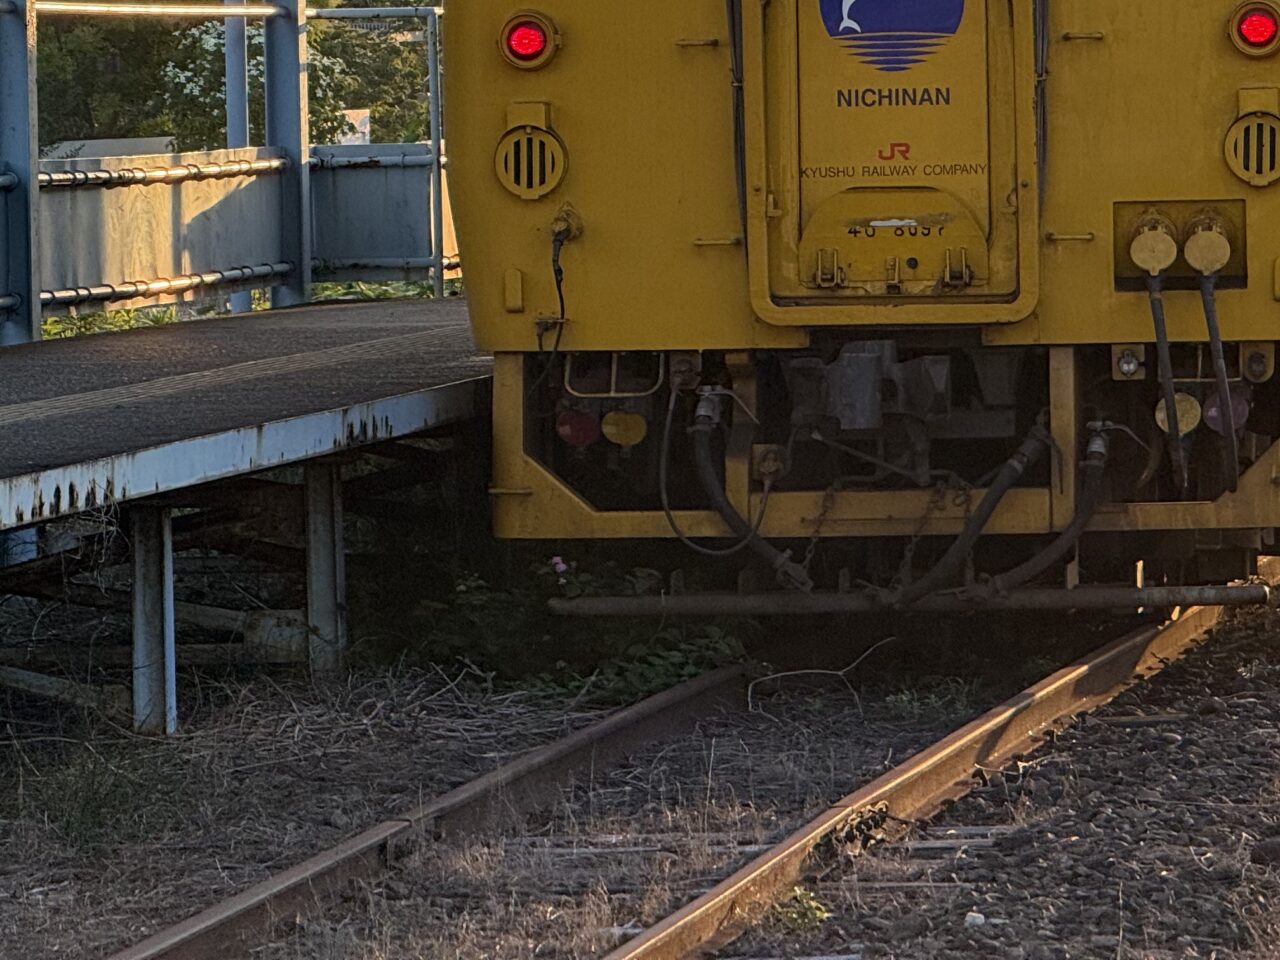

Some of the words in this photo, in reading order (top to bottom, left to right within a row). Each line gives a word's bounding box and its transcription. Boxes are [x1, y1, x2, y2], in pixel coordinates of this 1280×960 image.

[836, 87, 950, 107] NICHINAN
[878, 142, 911, 161] JR
[800, 166, 856, 179] KYUSHU
[861, 164, 918, 178] RAILWAY
[923, 163, 987, 177] COMPANY
